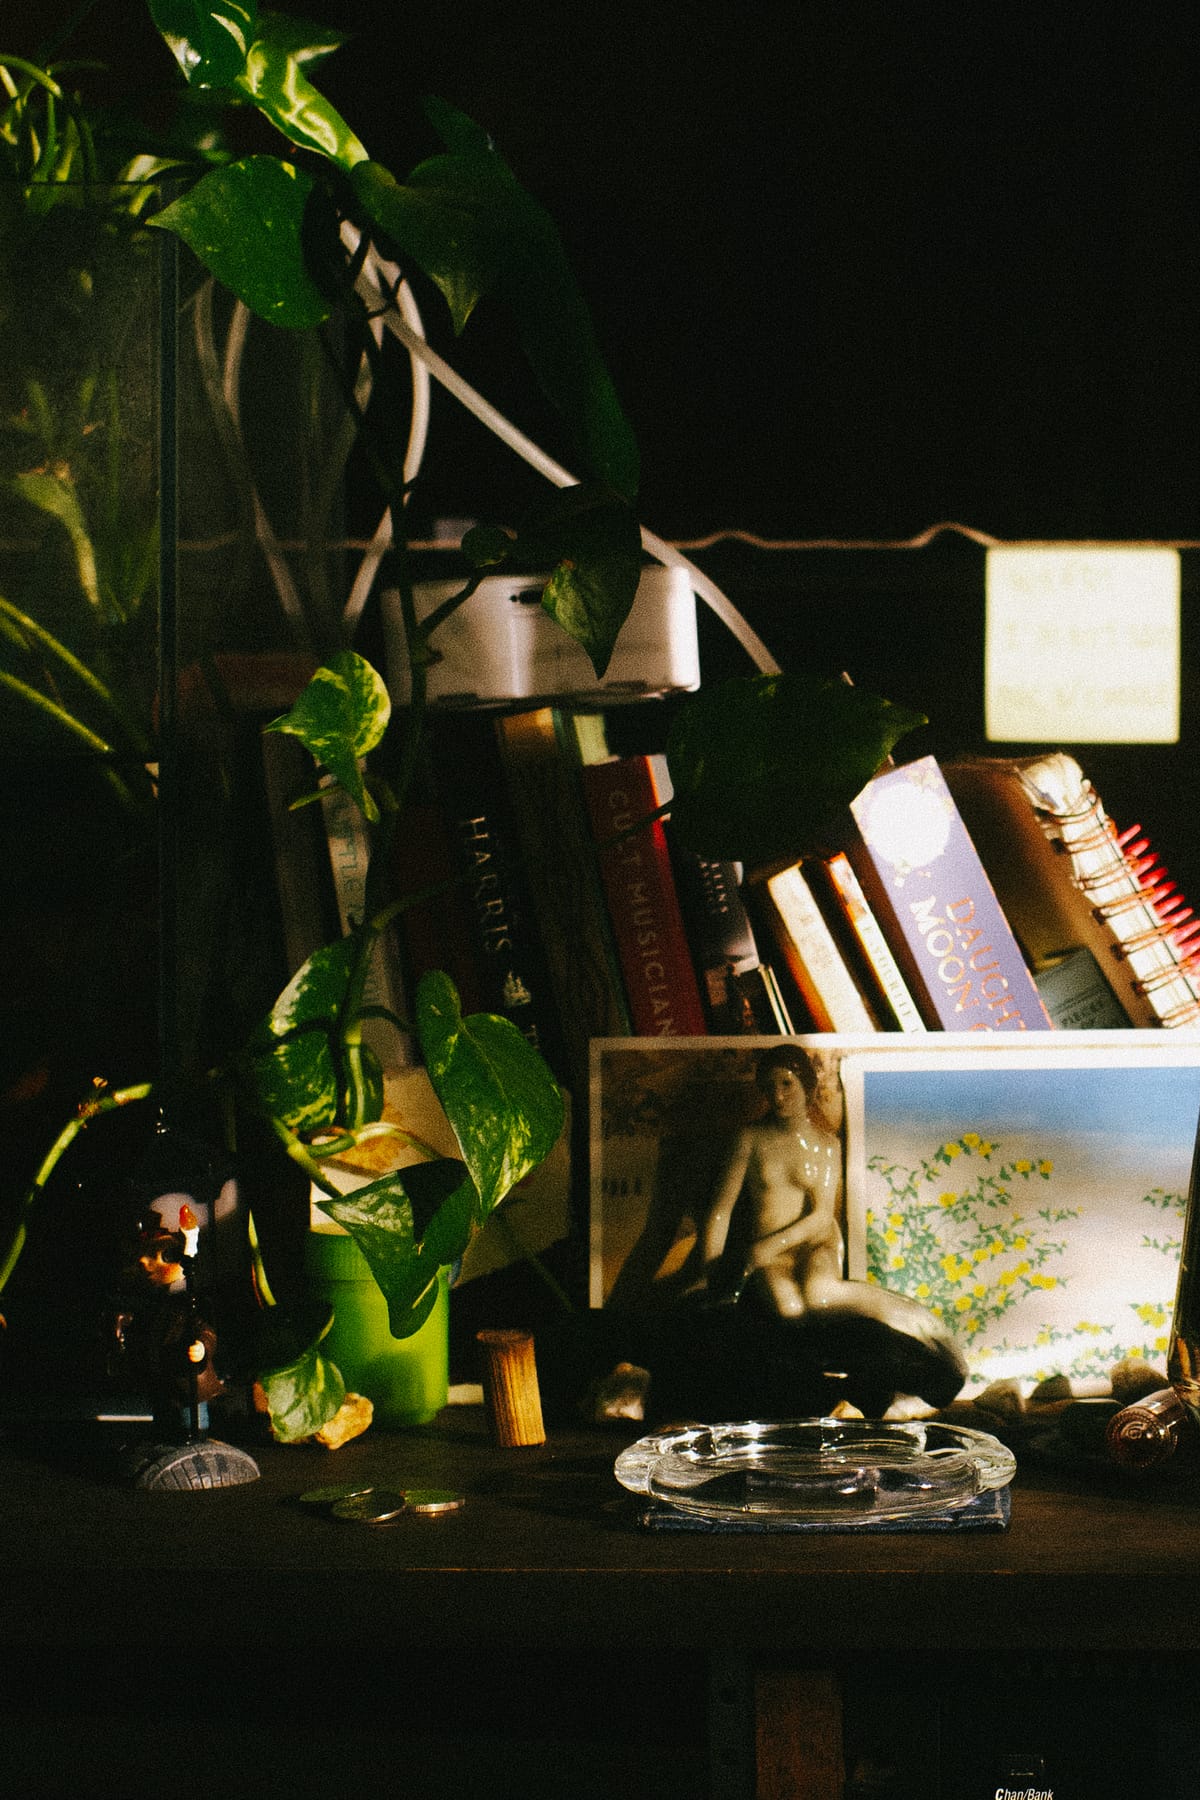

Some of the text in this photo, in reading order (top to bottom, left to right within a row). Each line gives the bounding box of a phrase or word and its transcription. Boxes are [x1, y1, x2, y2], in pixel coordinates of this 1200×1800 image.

[464, 815, 512, 953] HARRIS
[909, 895, 980, 1014] MOON
[994, 1787, 1055, 1800] Chan/Bank
